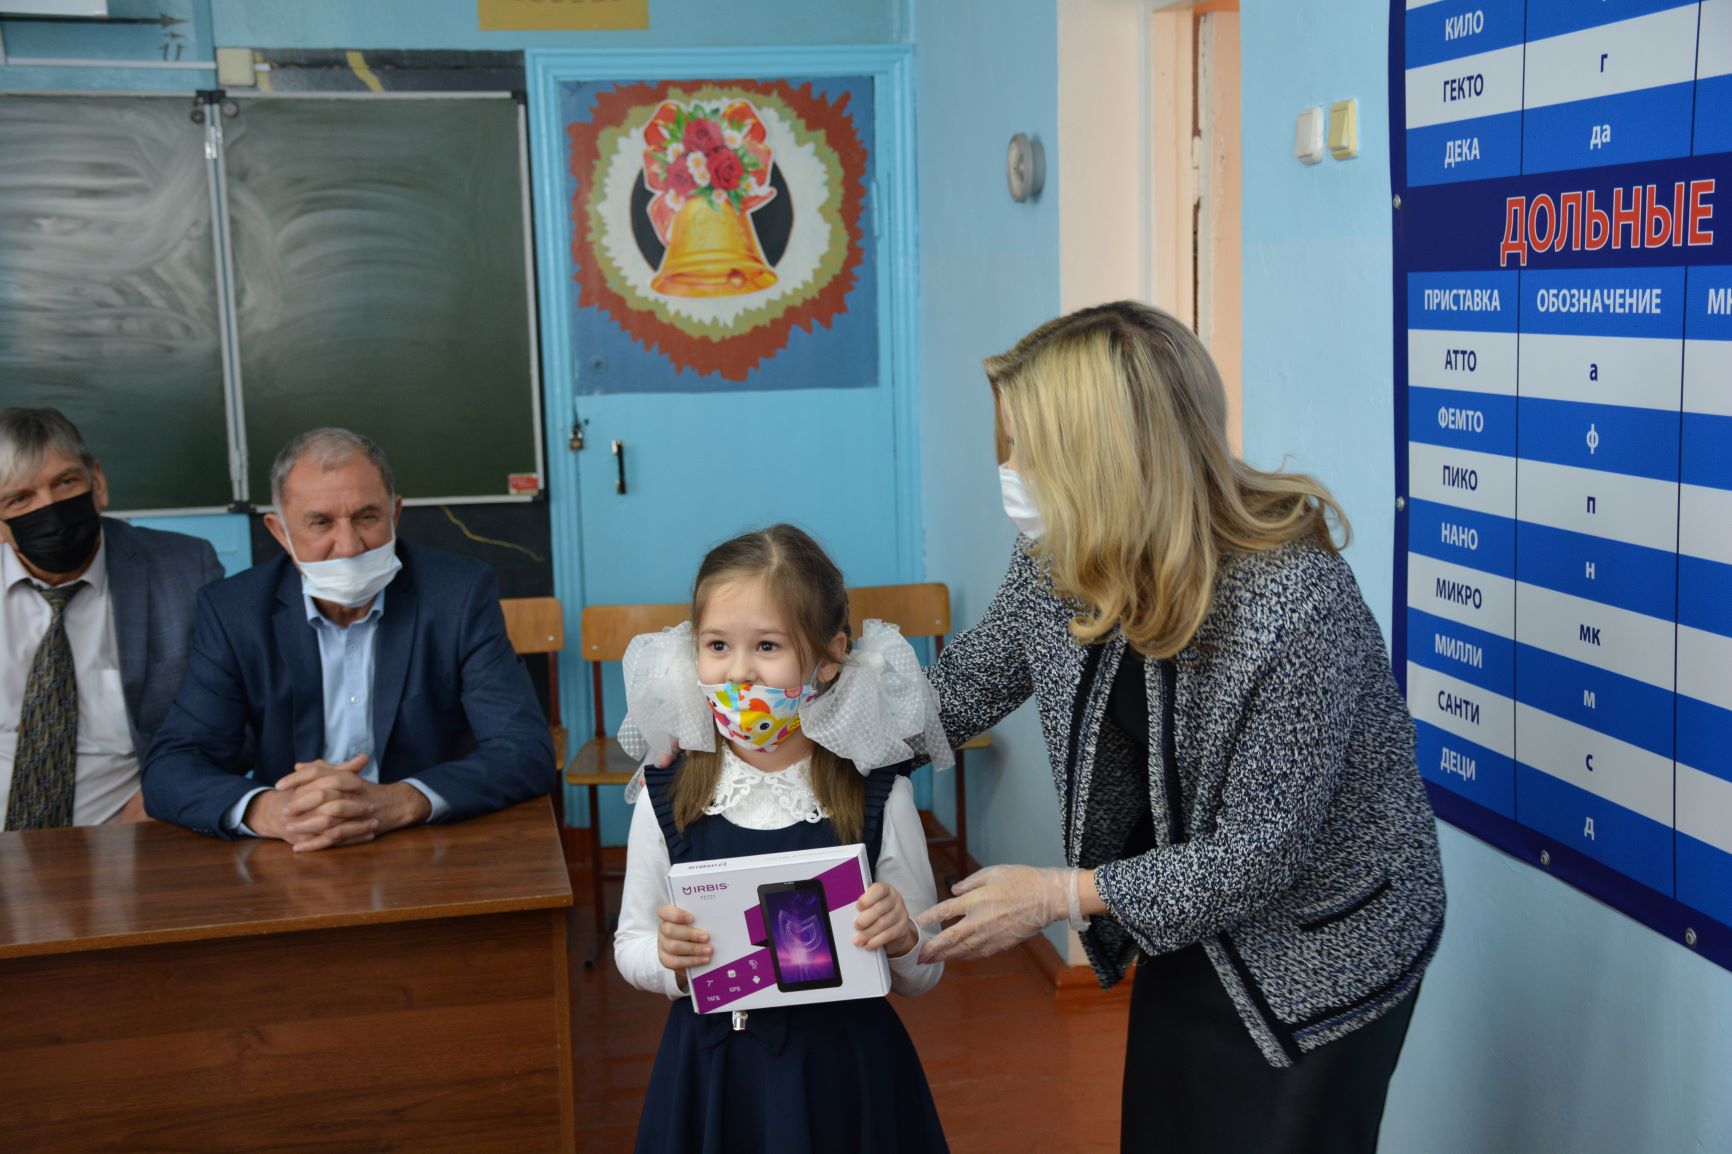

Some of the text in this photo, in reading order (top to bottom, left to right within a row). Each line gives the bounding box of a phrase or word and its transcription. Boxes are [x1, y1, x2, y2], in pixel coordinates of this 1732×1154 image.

[1446, 10, 1483, 40] КИЛО
[1600, 53, 1609, 73] г
[1444, 74, 1483, 102] ГЕКТО
[1590, 124, 1610, 150] да
[1445, 138, 1480, 168] ДЕКА
[1500, 179, 1715, 267] ДОЛЬНЫЕ
[1425, 289, 1500, 311] ПРИСТАВКА
[1537, 289, 1661, 313] ОБОЗНАЧЕНИЕ
[1445, 350, 1476, 371] АТТО
[1589, 363, 1598, 382] а
[1438, 407, 1483, 432] ФЕМТО
[1586, 423, 1600, 455] ф
[1443, 465, 1477, 491] ПИКО
[1586, 495, 1596, 515] п
[1442, 523, 1478, 550] НАНО
[1585, 561, 1596, 580] н
[1436, 578, 1482, 609] МИКРО
[1580, 624, 1600, 646] мк
[1434, 633, 1483, 669] МИЛЛИ
[1438, 690, 1480, 725] САНТИ
[1583, 689, 1596, 709] м
[1441, 747, 1475, 780] ДЕЦИ
[1585, 754, 1594, 772] с
[1583, 816, 1595, 841] д
[693, 882, 728, 893] IRBIS
